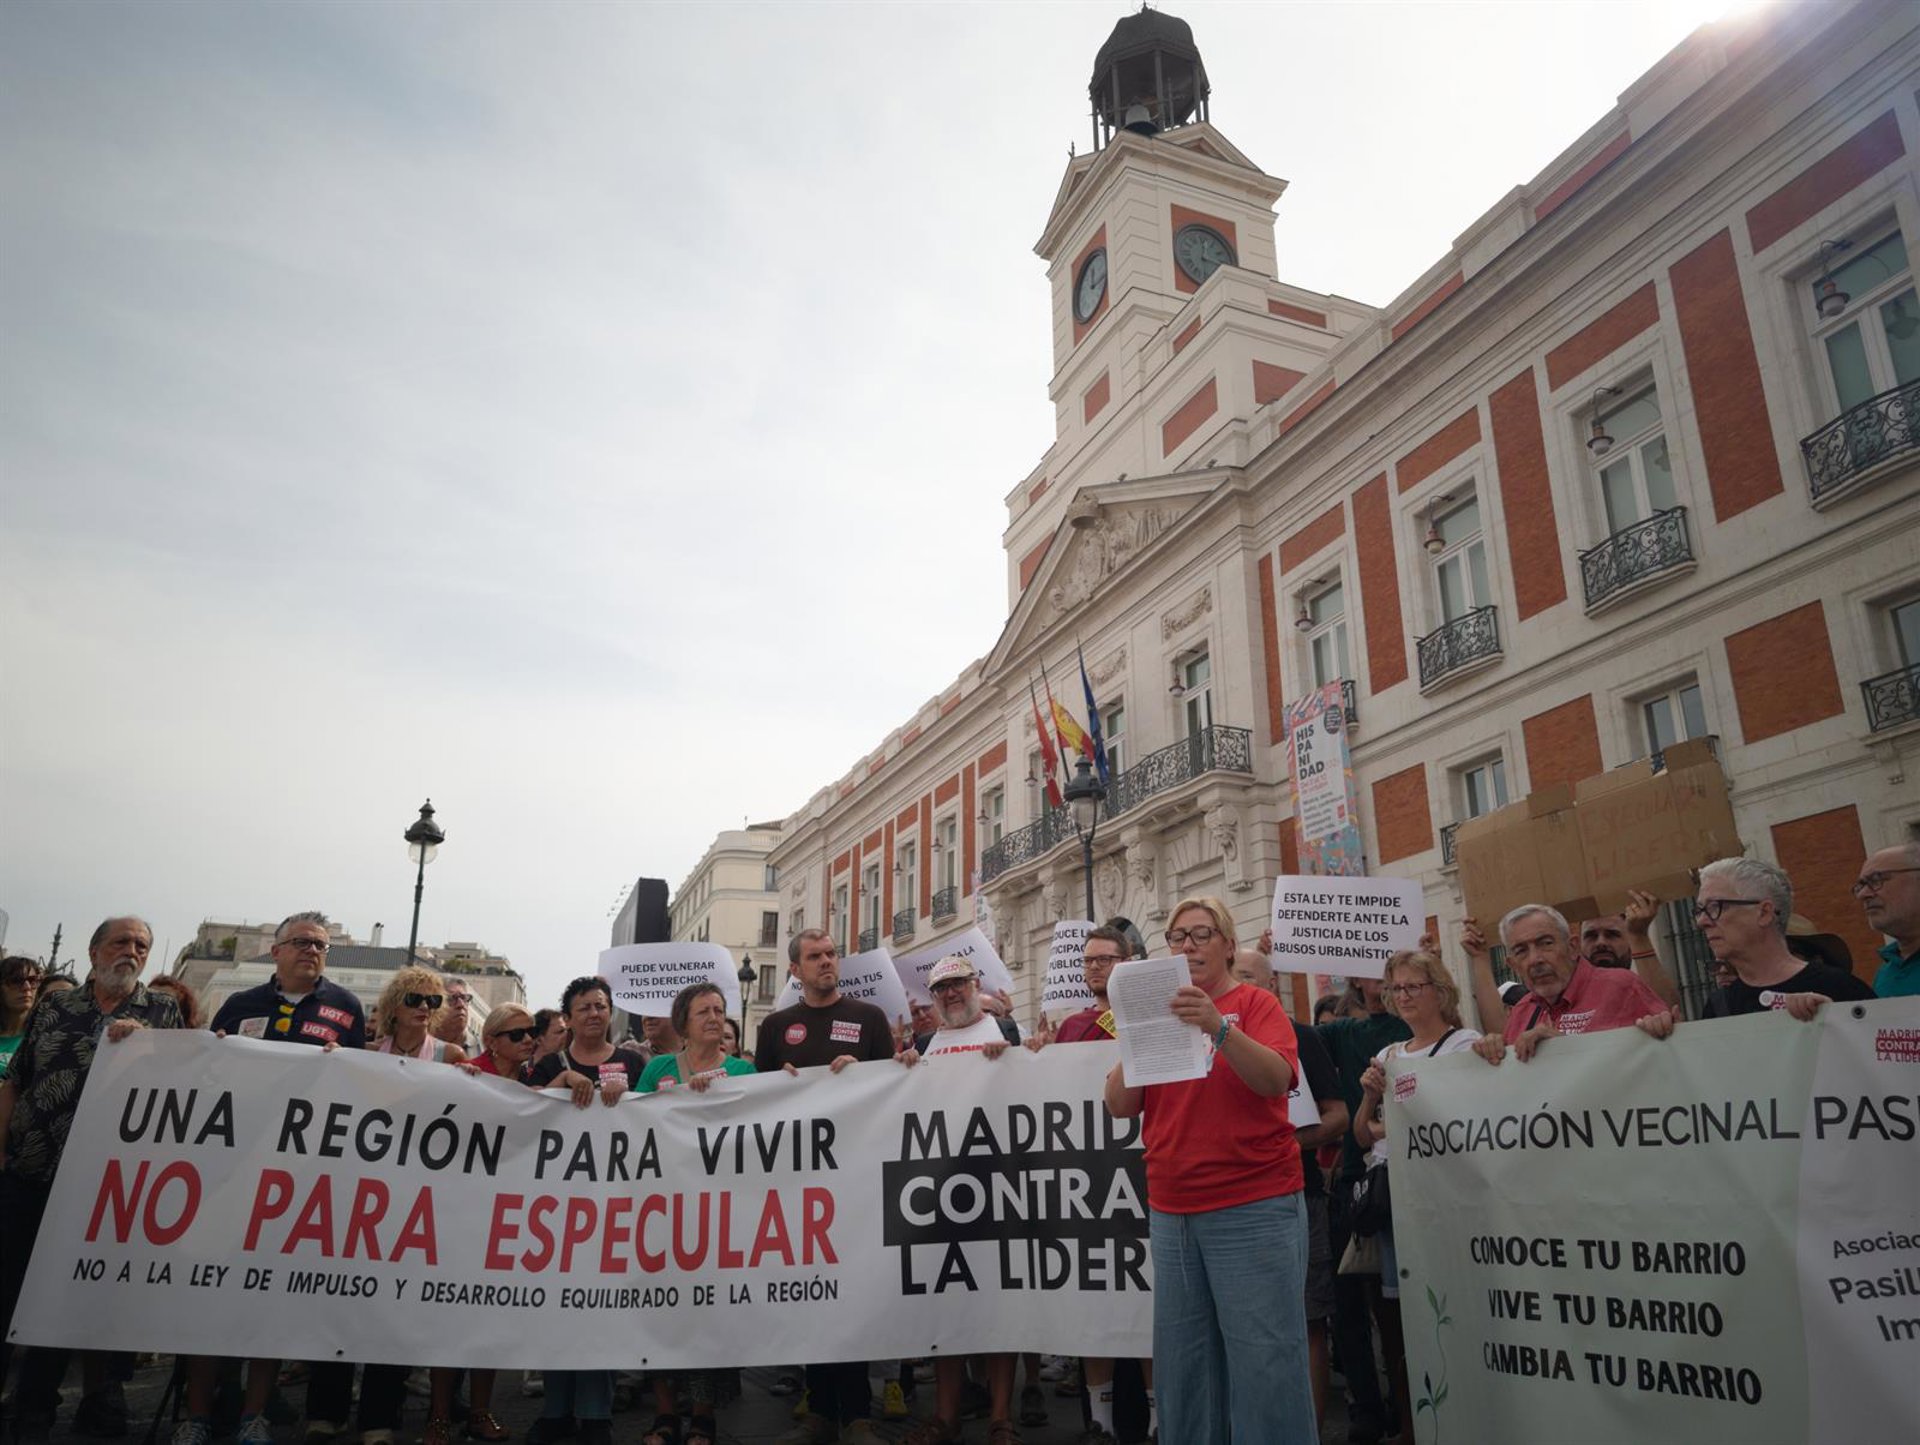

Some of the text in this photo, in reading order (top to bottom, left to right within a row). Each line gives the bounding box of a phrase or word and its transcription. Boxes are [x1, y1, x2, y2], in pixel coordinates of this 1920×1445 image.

[1296, 724, 1314, 742] HIS
[1297, 739, 1313, 754] PA
[1300, 761, 1325, 780] DAD
[1284, 893, 1401, 908] ESTA LEY TE IMPIDE
[1278, 909, 1409, 926] DEFENDERTE ANTE LA
[1291, 926, 1389, 942] JUSTICIA DE LOS
[962, 945, 975, 956] LA
[1274, 942, 1316, 955] ABUSOS
[621, 961, 715, 973] PUEDE VULNERAR
[629, 975, 708, 987] TUS DERECHOS
[863, 971, 883, 984] TUS
[863, 987, 877, 997] DE
[319, 1006, 342, 1022] UGT
[302, 1023, 328, 1037] UGT
[119, 1087, 839, 1182] UNA REGIÓN PARA VIVIR
[901, 1101, 1141, 1160] MADRID
[1407, 1102, 1595, 1160] ASOCIACIÓN
[1601, 1097, 1801, 1148] VECINAL
[899, 1168, 1146, 1226] CONTRA
[85, 1160, 839, 1274] NO PARA ESPECULAR
[1471, 1236, 1746, 1277] CONOCE TU BARRIO
[901, 1239, 1151, 1295] LA LIDER
[73, 1258, 838, 1310] NO A LA LEY DE IMPULSO Y DESARROLLO EQUILIBRADO DE LA REGIÓN
[1488, 1288, 1724, 1338] VIVE TU BARRIO
[1483, 1341, 1763, 1406] CAMBIA TU BARRIO
